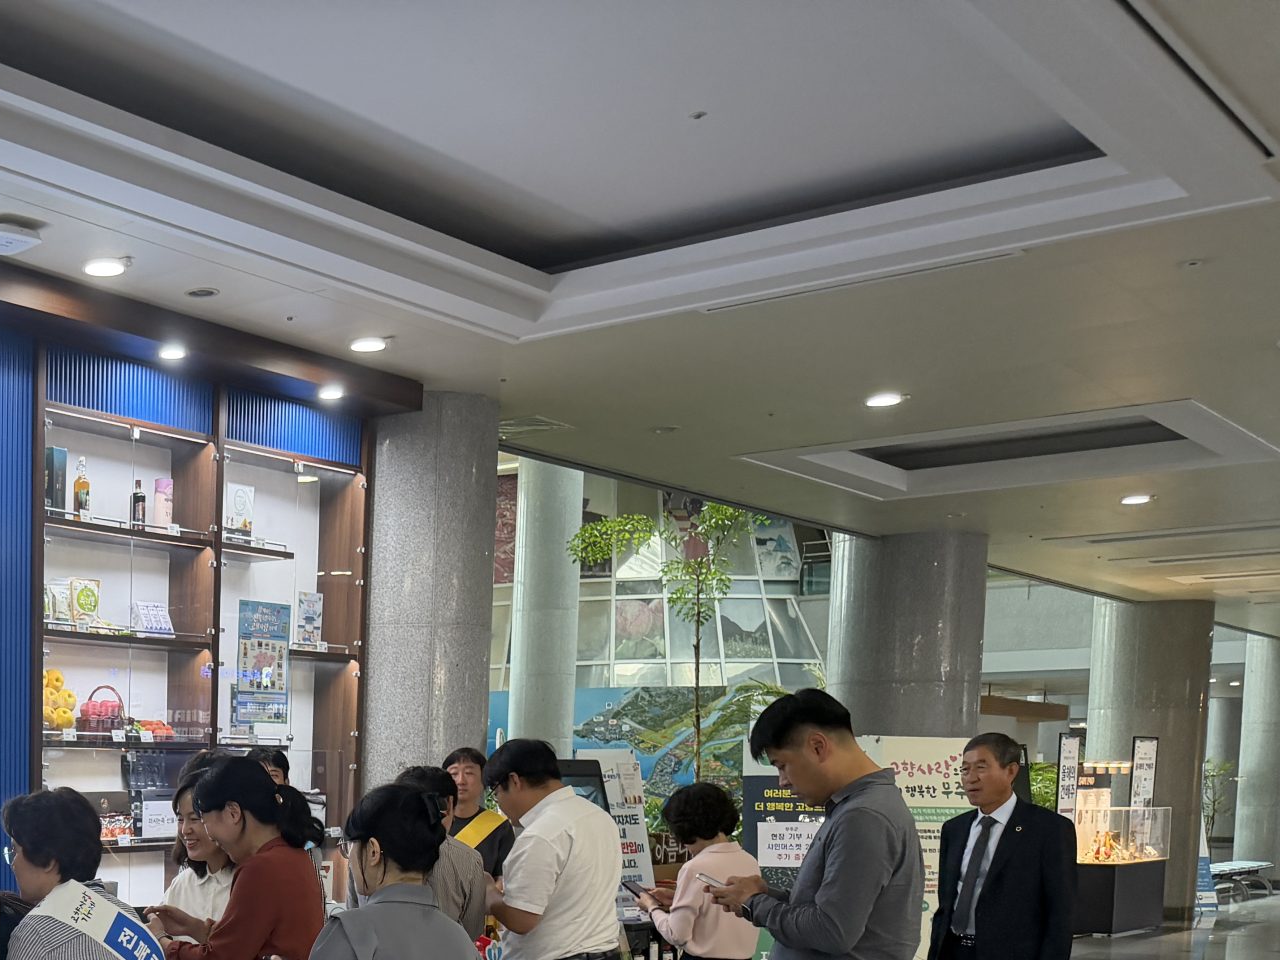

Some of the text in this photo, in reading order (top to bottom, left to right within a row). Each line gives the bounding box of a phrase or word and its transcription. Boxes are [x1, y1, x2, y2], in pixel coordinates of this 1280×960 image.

[764, 789, 798, 798] 여러분
[905, 785, 937, 798] 행복한
[612, 814, 640, 825] 자치도
[622, 859, 638, 869] 니다.
